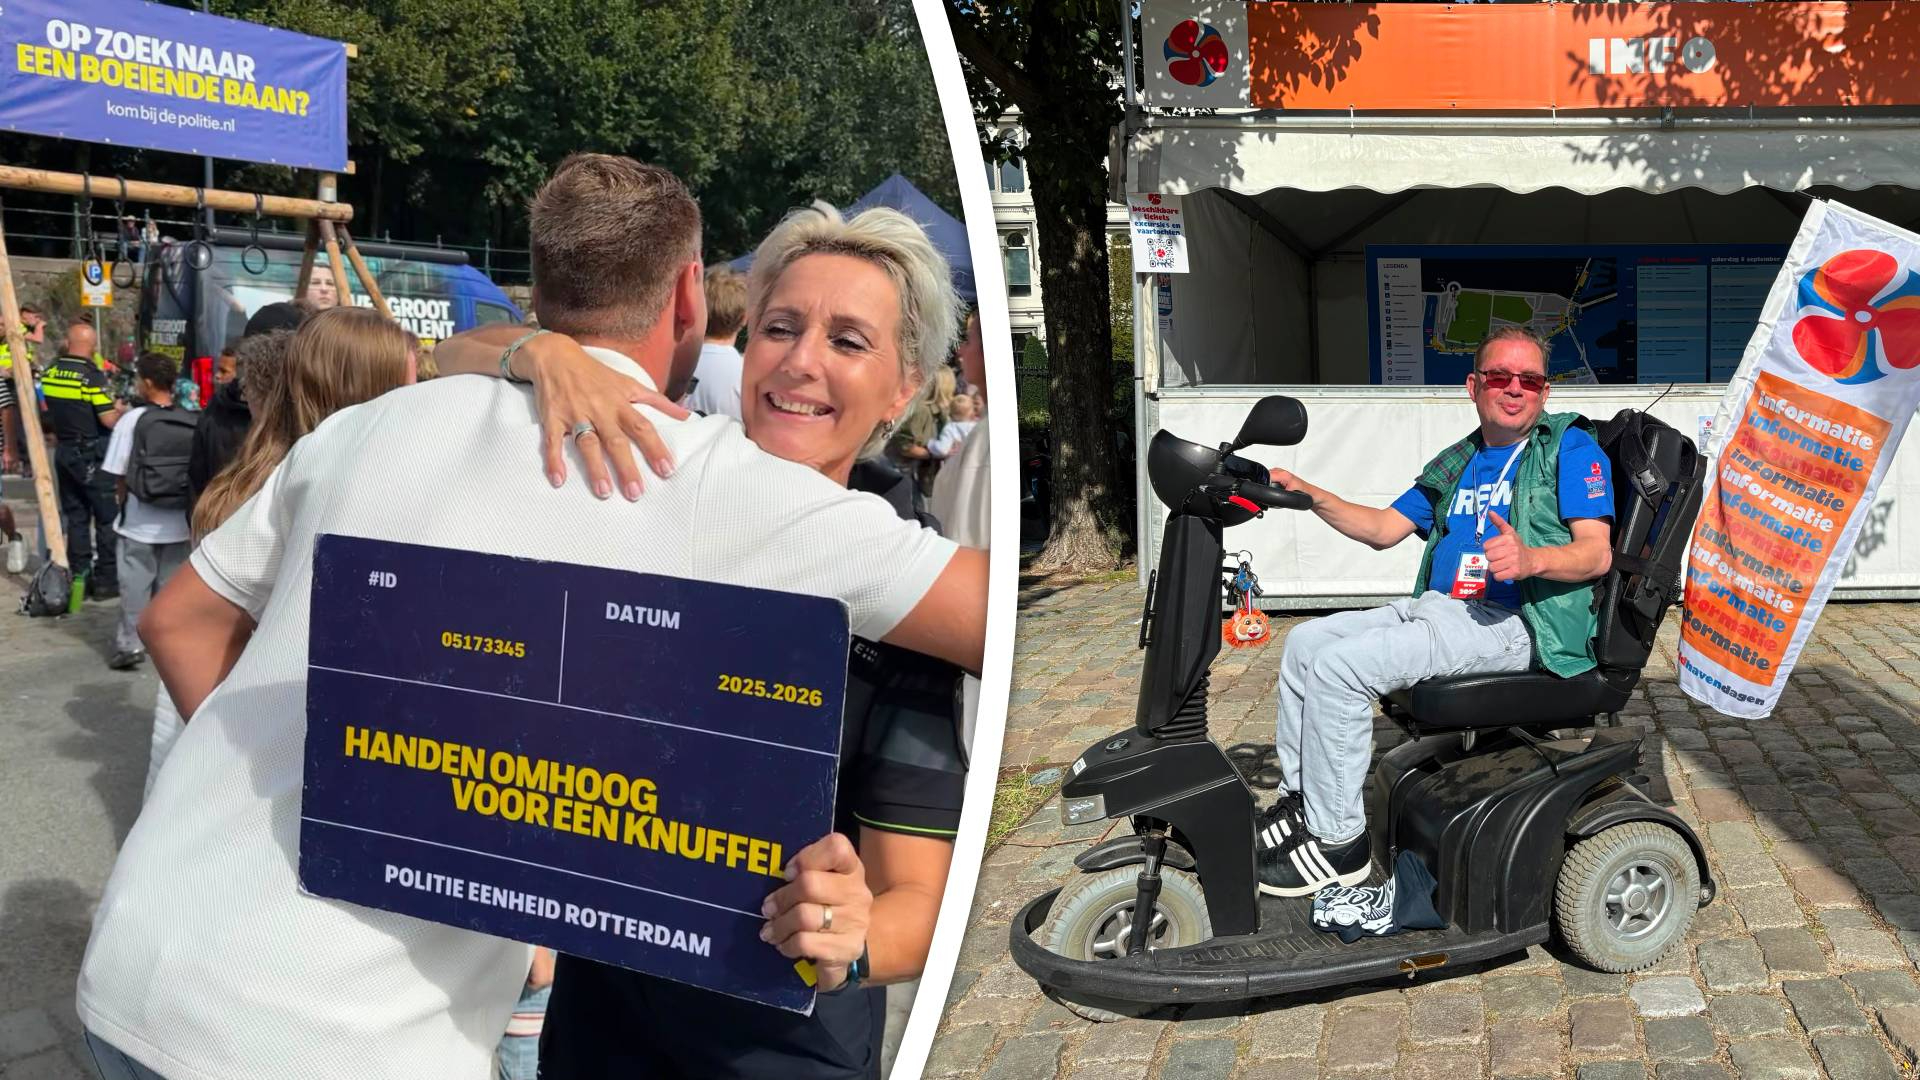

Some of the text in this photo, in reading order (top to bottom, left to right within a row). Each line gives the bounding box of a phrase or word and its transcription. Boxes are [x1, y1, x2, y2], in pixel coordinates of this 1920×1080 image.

[17, 43, 310, 116] EEN BOEIENDE BAAN?
[46, 20, 256, 82] OP ZOEK NAAR
[1589, 37, 1716, 74] INFO
[1132, 205, 1179, 214] beschikbare
[392, 317, 455, 339] ALENT
[1748, 410, 1863, 471] informatie
[1758, 390, 1874, 450] informatie
[1447, 480, 1512, 517] REW
[1721, 464, 1833, 532] informatie
[1730, 448, 1845, 511] informatie
[1721, 489, 1823, 552] nformatie
[368, 570, 397, 590] #ID
[1688, 566, 1786, 633] nformatie
[1691, 542, 1794, 614] informatie
[441, 630, 526, 658] 05173345
[605, 602, 681, 631] DATUM
[717, 673, 823, 708] 2025.2026
[344, 726, 658, 815] HANDEN OMHOOG
[451, 777, 787, 880] VOOR EEN KNUFFEL
[385, 863, 712, 957] POLITIE EENHEID ROTTERDAM
